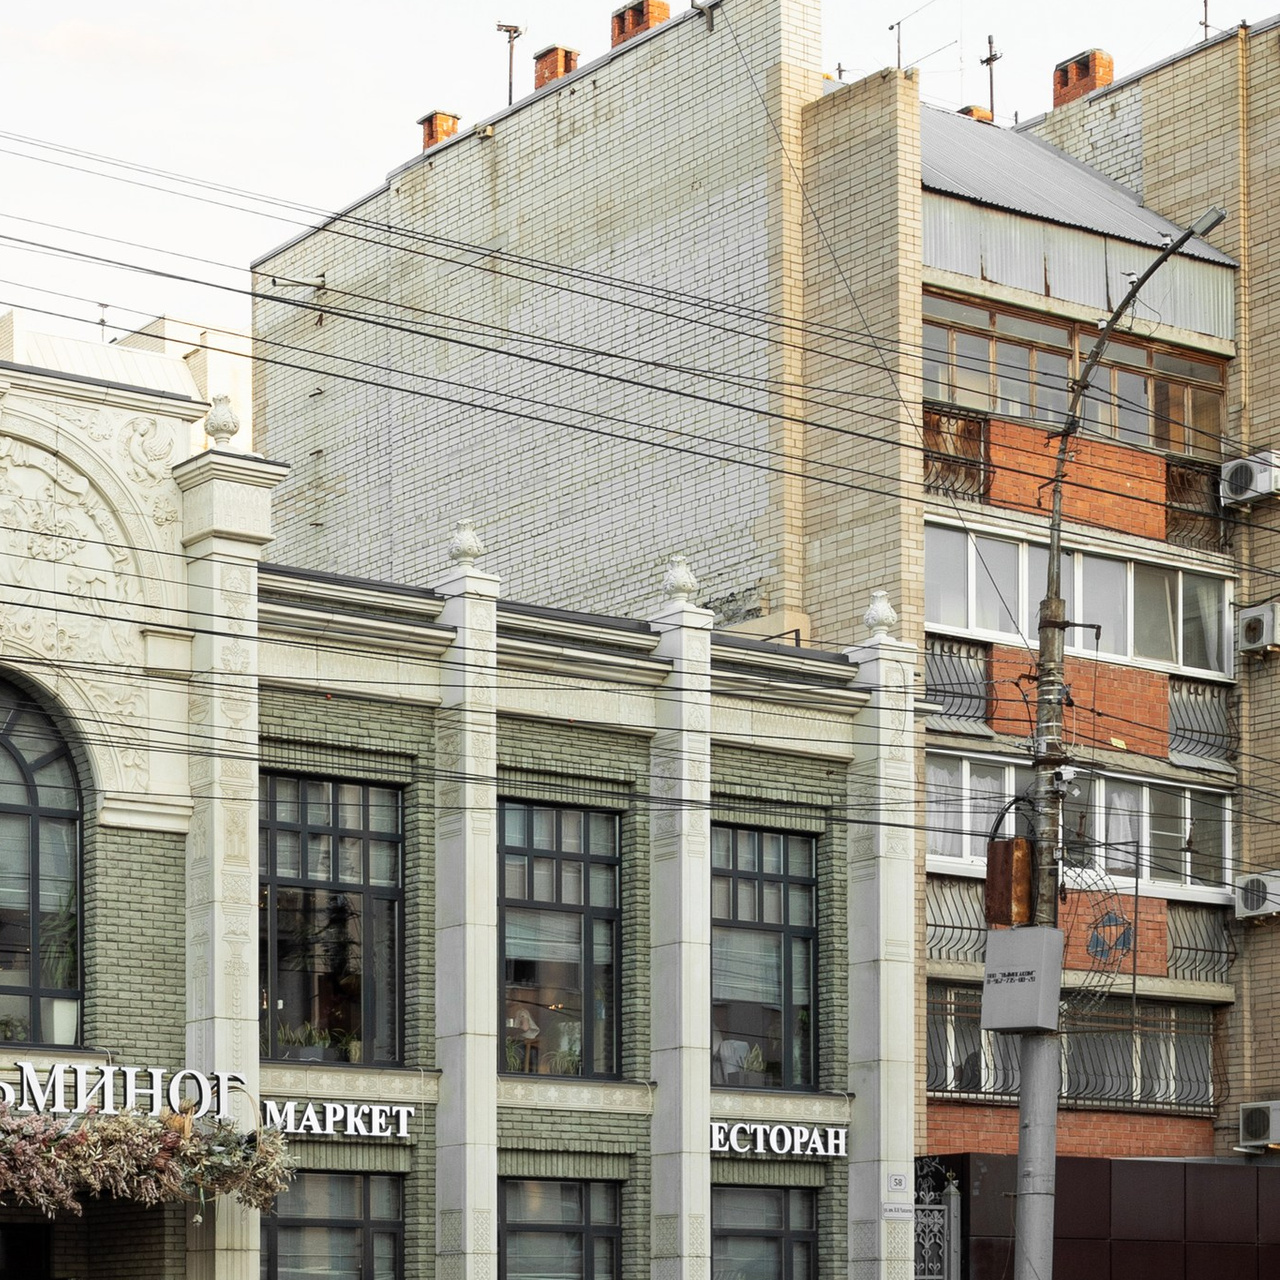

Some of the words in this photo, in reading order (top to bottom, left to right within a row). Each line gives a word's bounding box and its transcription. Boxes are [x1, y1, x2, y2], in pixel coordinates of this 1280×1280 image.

[263, 1100, 415, 1137] МАРКЕТ
[710, 1122, 848, 1157] ЕСТОРАН
[893, 1178, 903, 1187] 58
